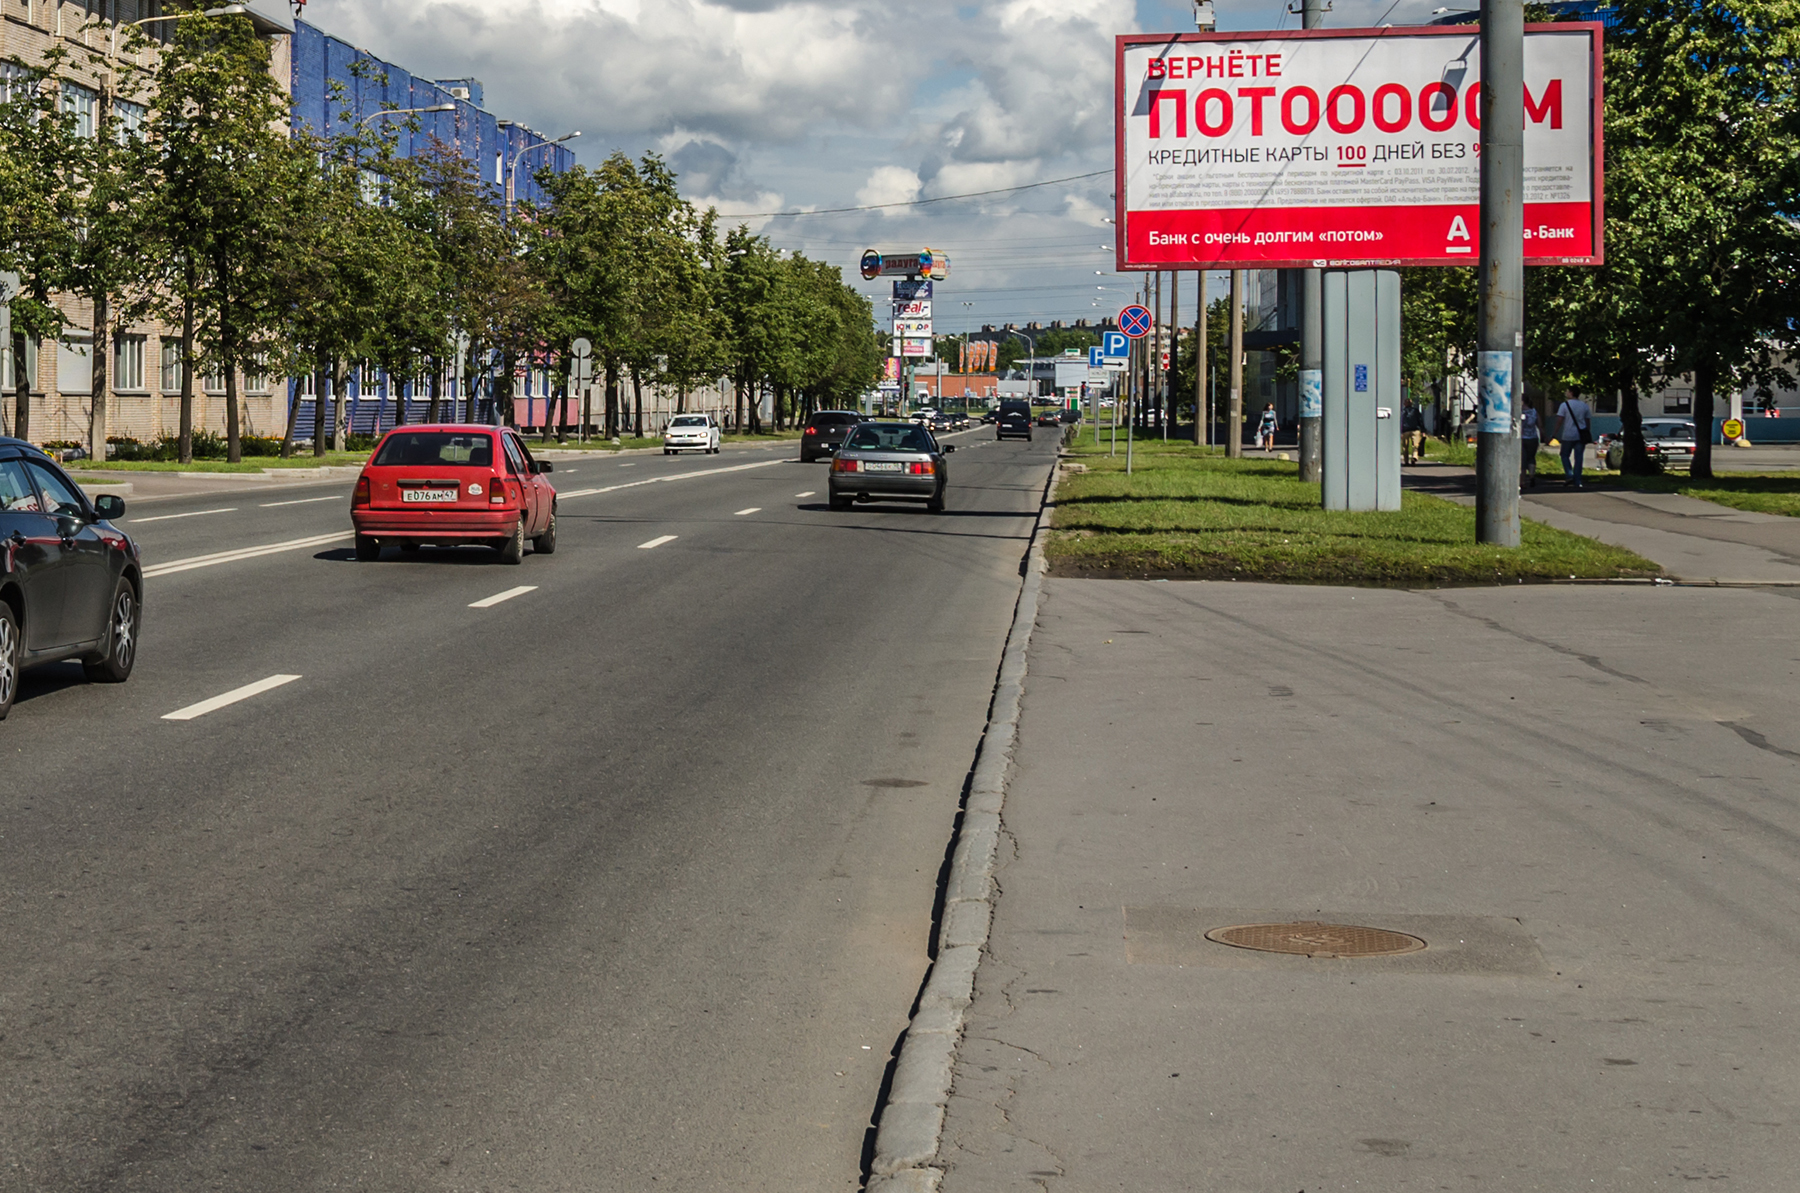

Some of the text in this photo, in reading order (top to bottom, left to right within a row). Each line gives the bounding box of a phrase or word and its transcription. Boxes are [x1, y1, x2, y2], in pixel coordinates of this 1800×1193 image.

[1148, 50, 1282, 80] ВЕРНЁТЕ
[1148, 148, 1260, 167] КРЕДИТНЫЕ
[1266, 146, 1329, 162] КАРТЫ
[1337, 145, 1366, 161] 100
[1372, 141, 1424, 162] ДНЕЙ
[1432, 143, 1466, 159] БЕЗ
[1149, 230, 1384, 245] Банк с очень долгим «потом»
[1110, 335, 1125, 355] P
